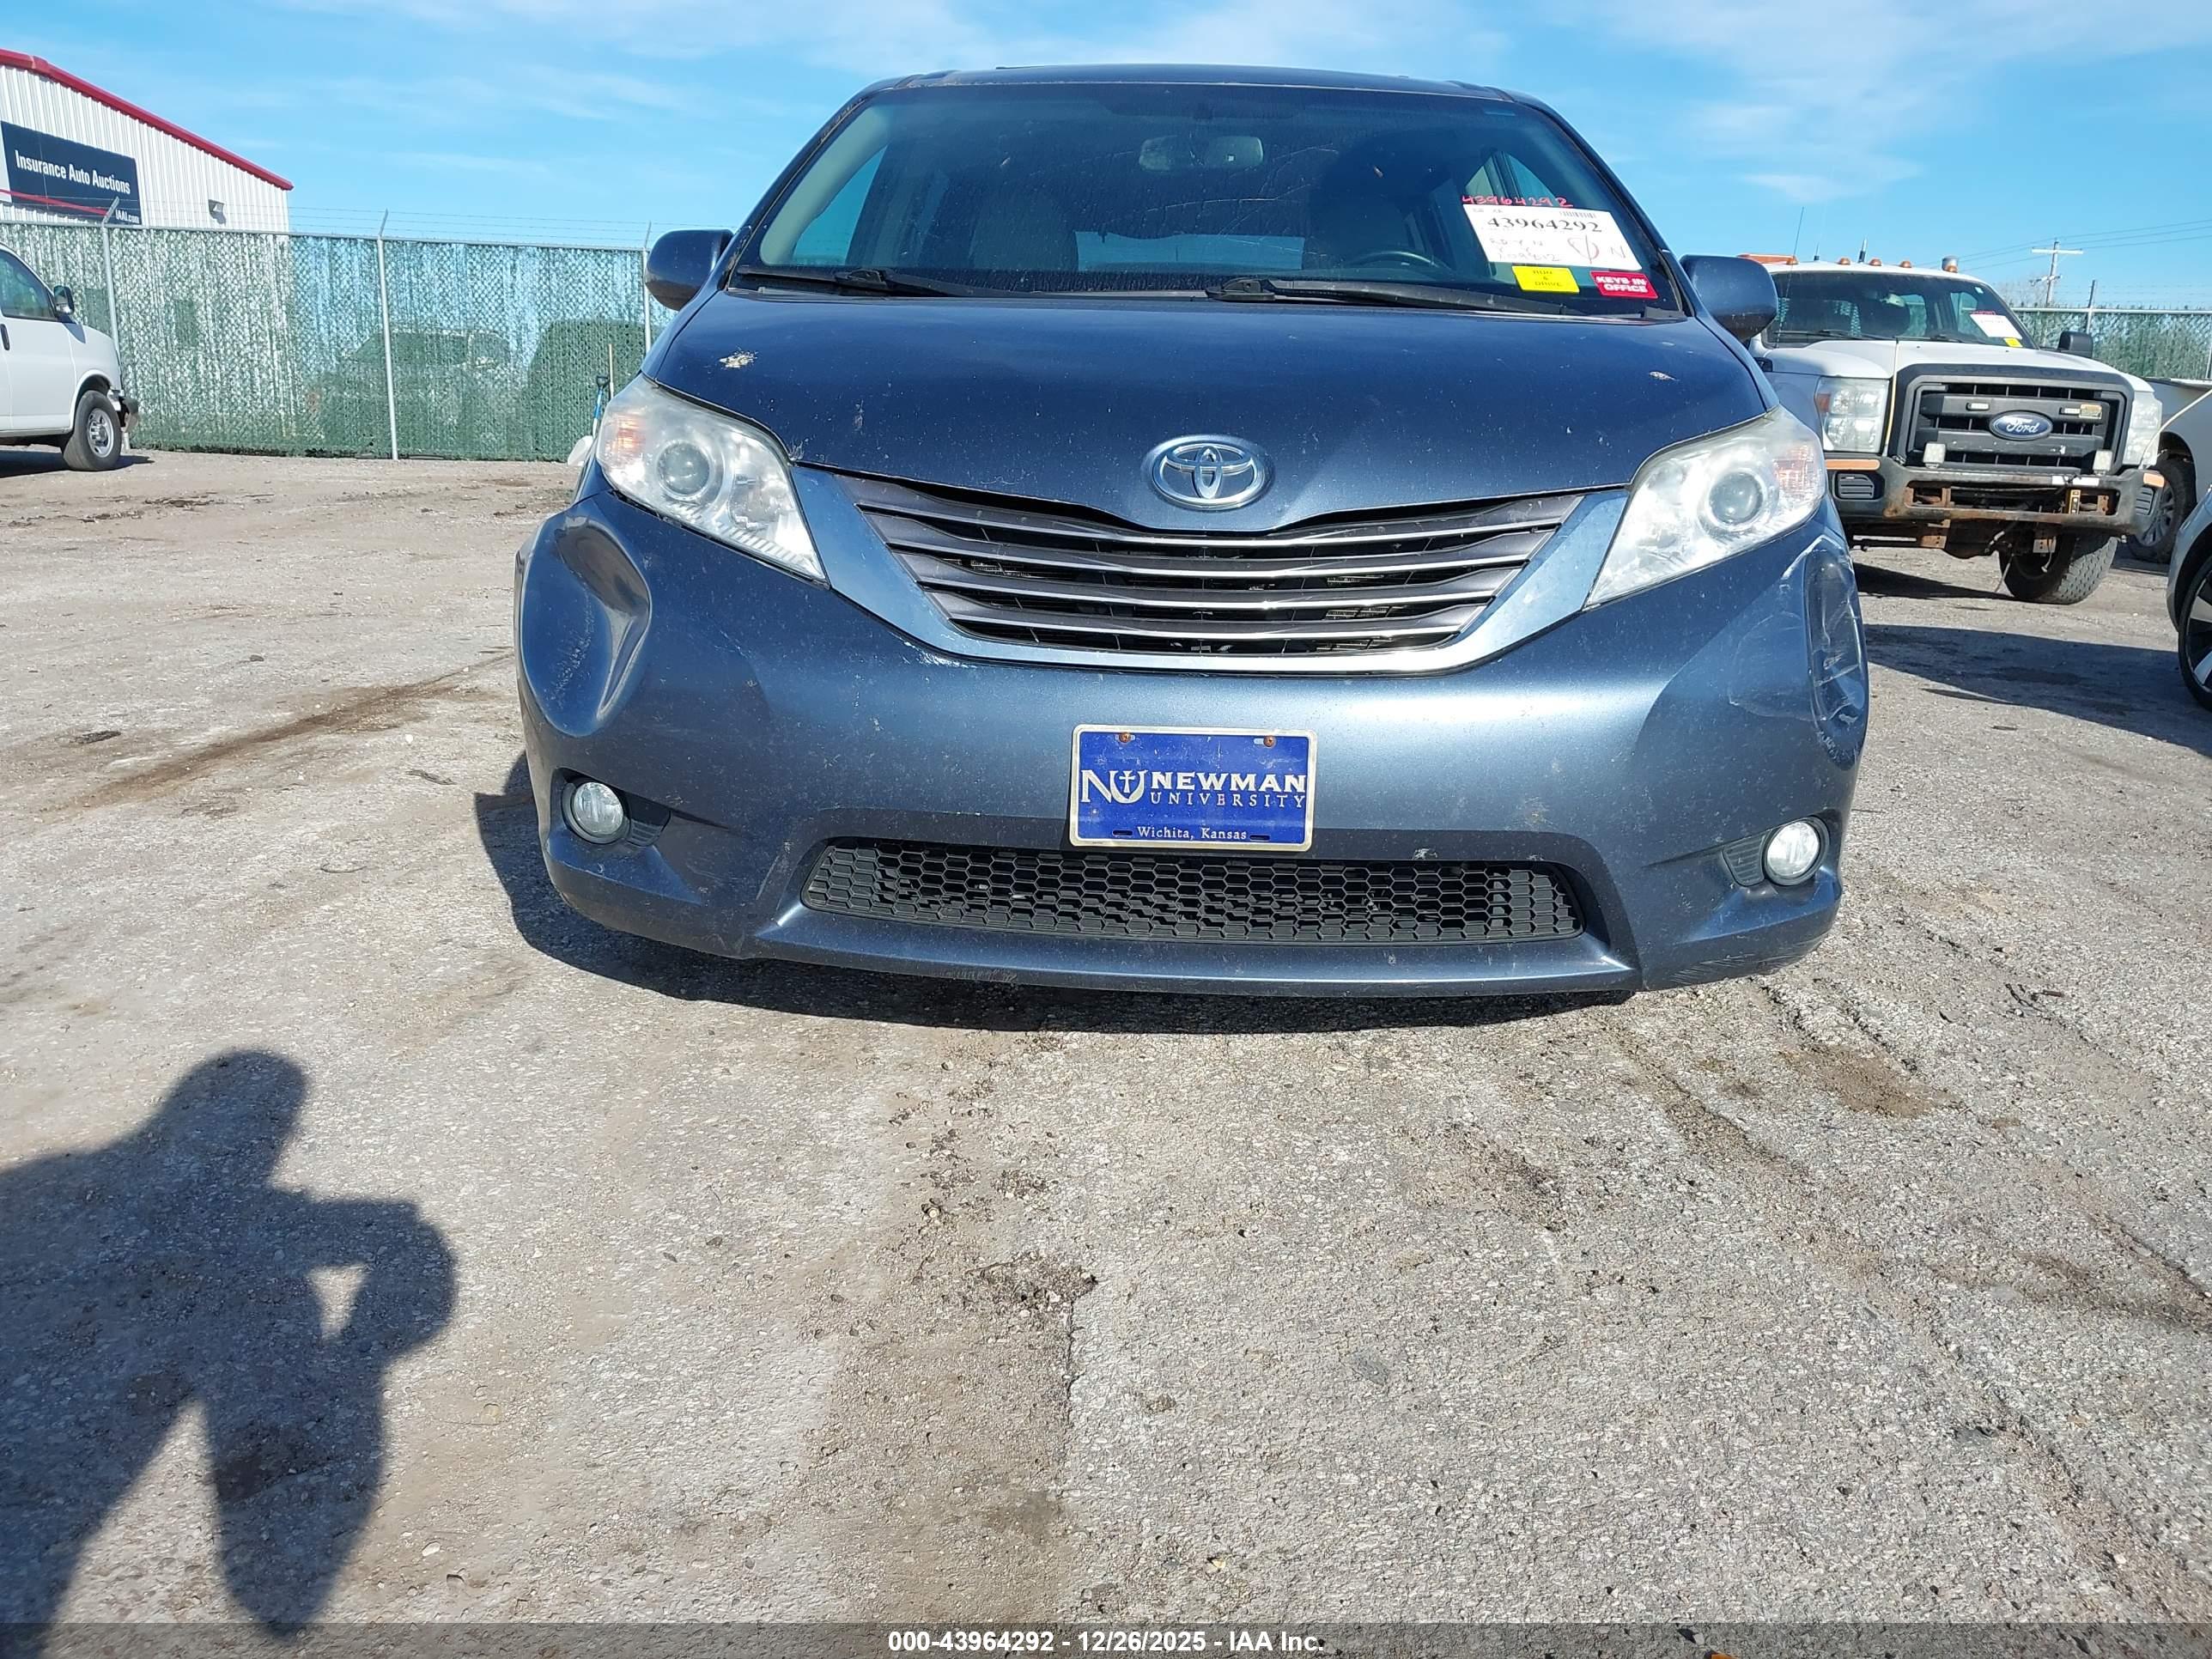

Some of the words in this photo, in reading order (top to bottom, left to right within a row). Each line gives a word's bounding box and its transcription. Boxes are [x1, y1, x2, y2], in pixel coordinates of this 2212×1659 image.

[15, 149, 67, 179] Insurance
[69, 163, 90, 185] Auto
[92, 169, 131, 195] Auctions
[1462, 195, 1574, 209] 43964292
[1487, 216, 1603, 234] 43964292
[1595, 276, 1632, 285] KEYS
[1632, 276, 1647, 286] IN
[1602, 283, 1649, 294] OFFICE
[2006, 417, 2040, 434] Ford
[1151, 771, 1307, 793] NEWMAN
[1151, 792, 1306, 808] UNIVERSITY
[1137, 826, 1194, 841] Wichita,
[1200, 827, 1248, 840] Kansas
